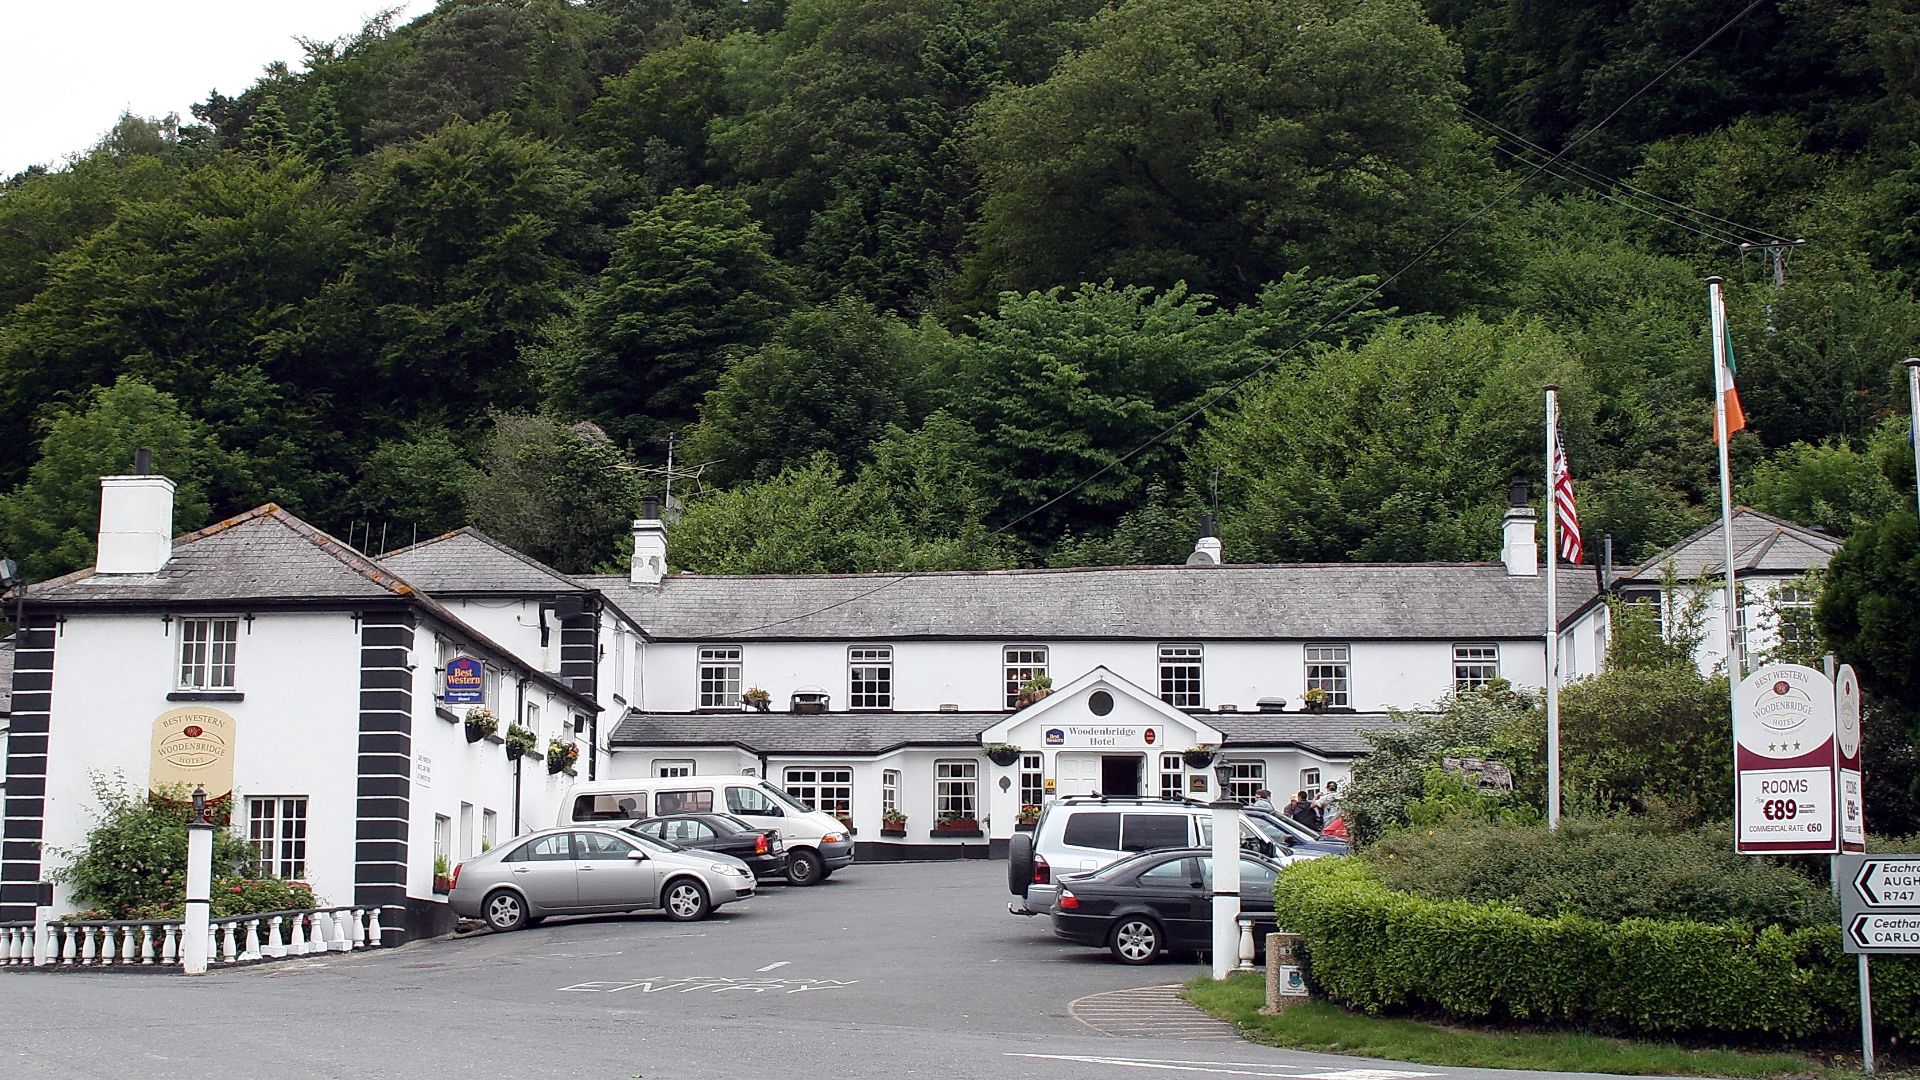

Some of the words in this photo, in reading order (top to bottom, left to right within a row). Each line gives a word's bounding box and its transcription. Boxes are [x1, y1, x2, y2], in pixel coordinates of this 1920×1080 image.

[454, 668, 473, 677] Best
[448, 675, 480, 684] Western
[1754, 673, 1773, 689] BEST
[1773, 670, 1809, 683] WESTERN
[1752, 701, 1813, 719] WOODENBRIDGE
[162, 715, 183, 728] BEST
[184, 714, 226, 728] WESTERN
[1772, 718, 1795, 726] HOTEL
[1069, 727, 1136, 737] Woodenbridge
[1090, 738, 1115, 746] Hotel
[158, 742, 226, 757] WOODENBRIDGE
[1762, 779, 1808, 794] ROOMS
[1763, 799, 1797, 820] €89
[1807, 823, 1822, 832] €60
[1884, 877, 1920, 886] AUGH
[1884, 891, 1915, 900] R747
[1874, 932, 1920, 942] CARLO
[557, 981, 844, 993] ENTRY
